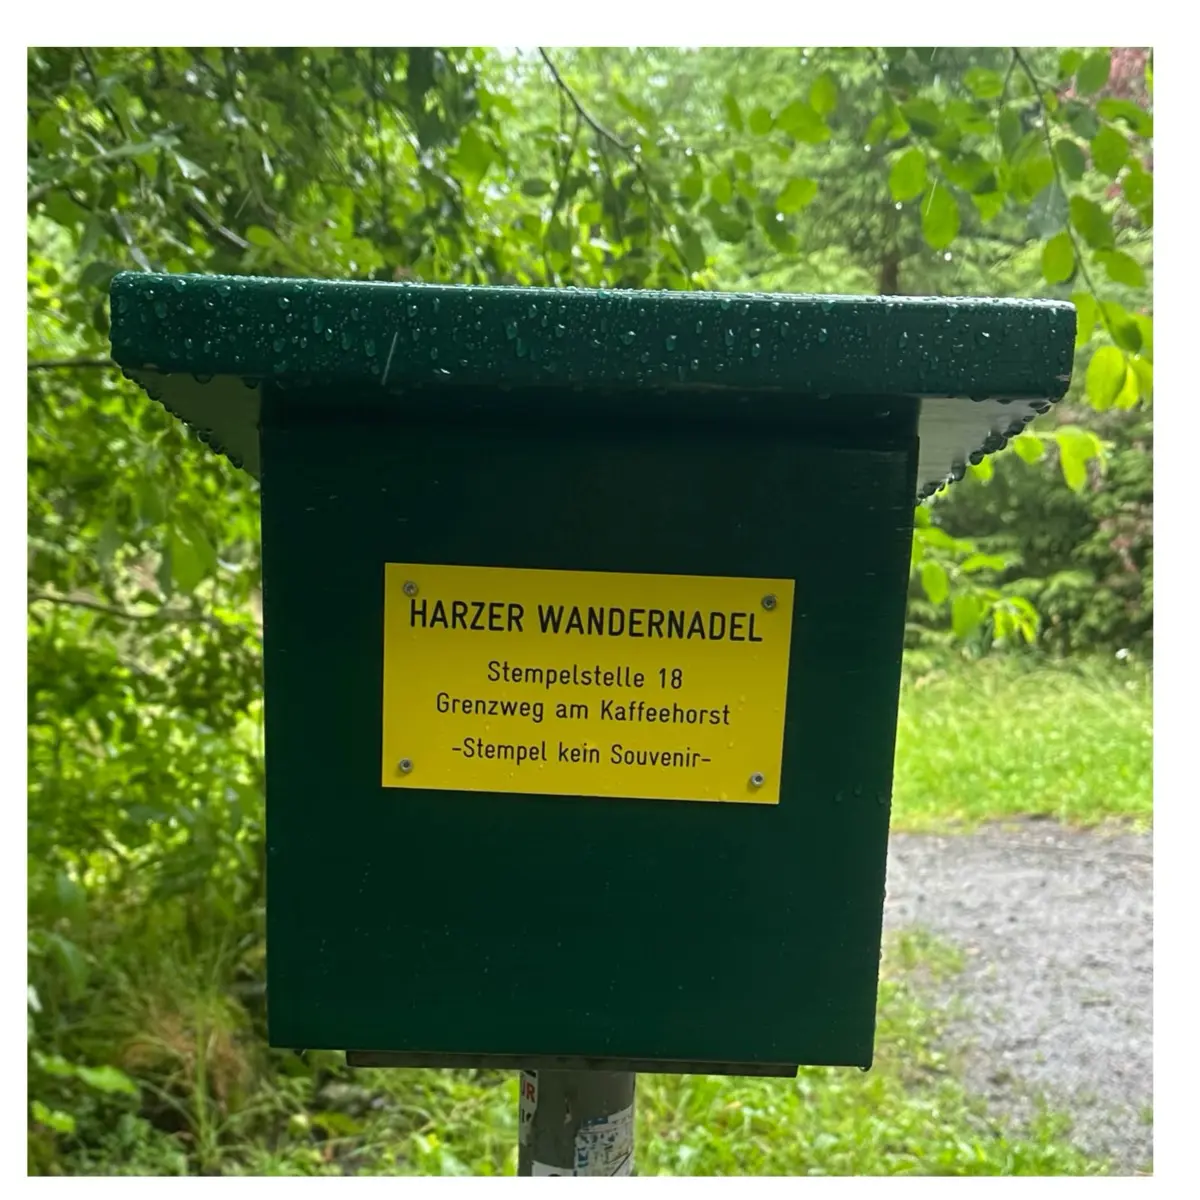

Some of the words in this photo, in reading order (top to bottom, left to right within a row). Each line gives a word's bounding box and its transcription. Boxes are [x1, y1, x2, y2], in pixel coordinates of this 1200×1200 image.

[408, 598, 526, 633] HARZER
[537, 603, 764, 643] WANDERNADEL
[487, 660, 646, 690] Stempelstelle
[657, 668, 684, 690] 18
[435, 692, 545, 724] Grenzweg
[554, 703, 590, 721] am
[599, 700, 732, 726] Kaffeehorst
[451, 737, 547, 765] -Stempel
[557, 741, 601, 764] kein
[610, 744, 712, 769] Souvenir-
